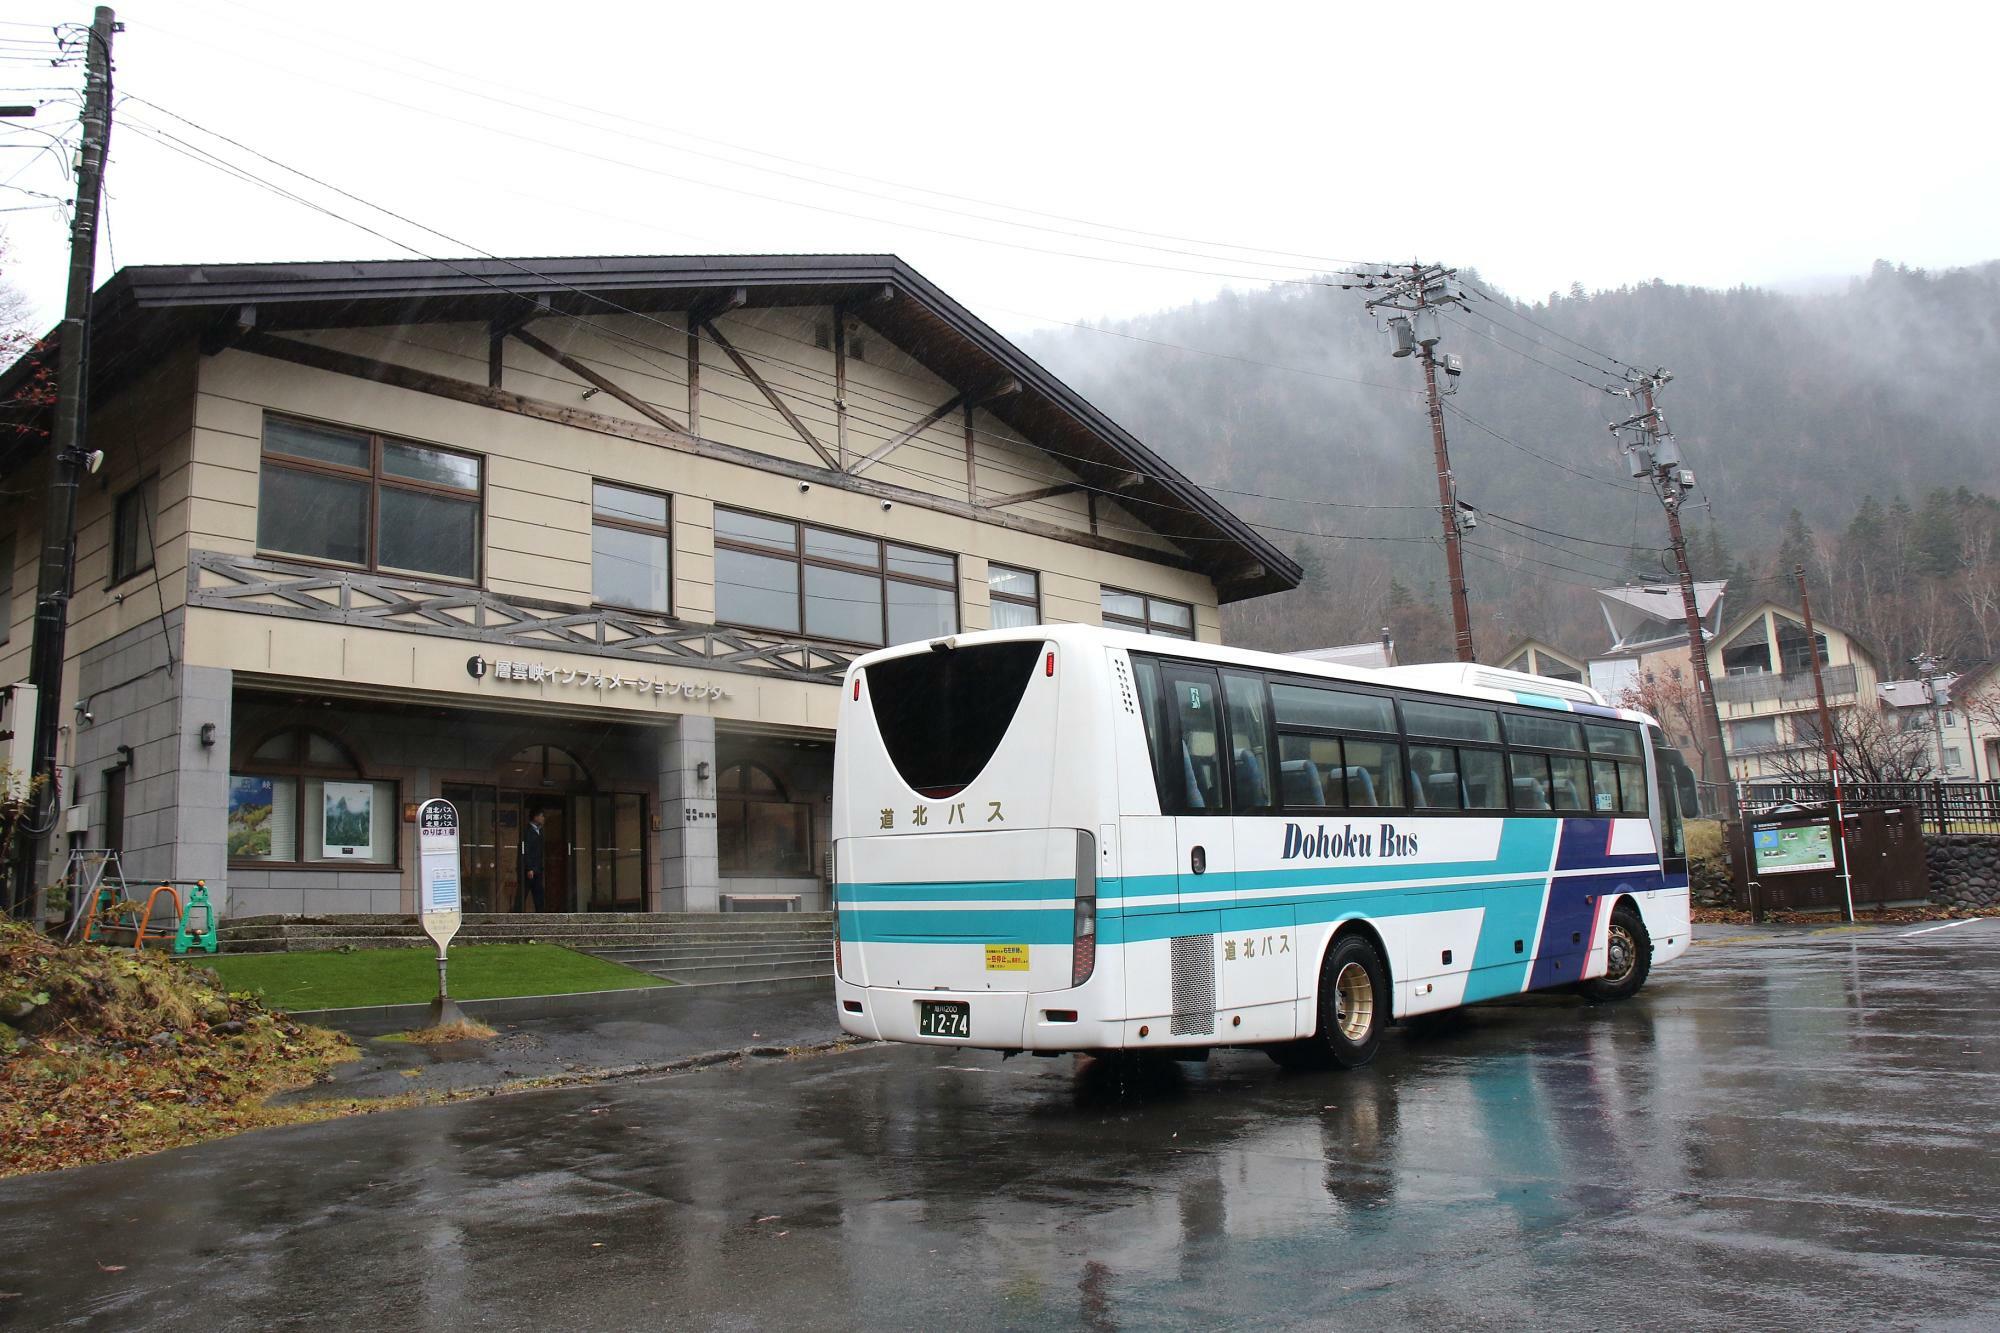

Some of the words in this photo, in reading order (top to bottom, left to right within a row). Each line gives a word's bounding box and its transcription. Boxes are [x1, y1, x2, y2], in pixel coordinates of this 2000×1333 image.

[494, 659, 736, 701] 層雲峡インフォメーションセンター
[426, 806, 452, 814] 道北バス
[879, 801, 1005, 829] 道北バス
[426, 820, 453, 828] 北見バス
[1281, 823, 1372, 859] Dohoku
[1378, 823, 1418, 857] Bus
[1225, 934, 1290, 961] 道北バス
